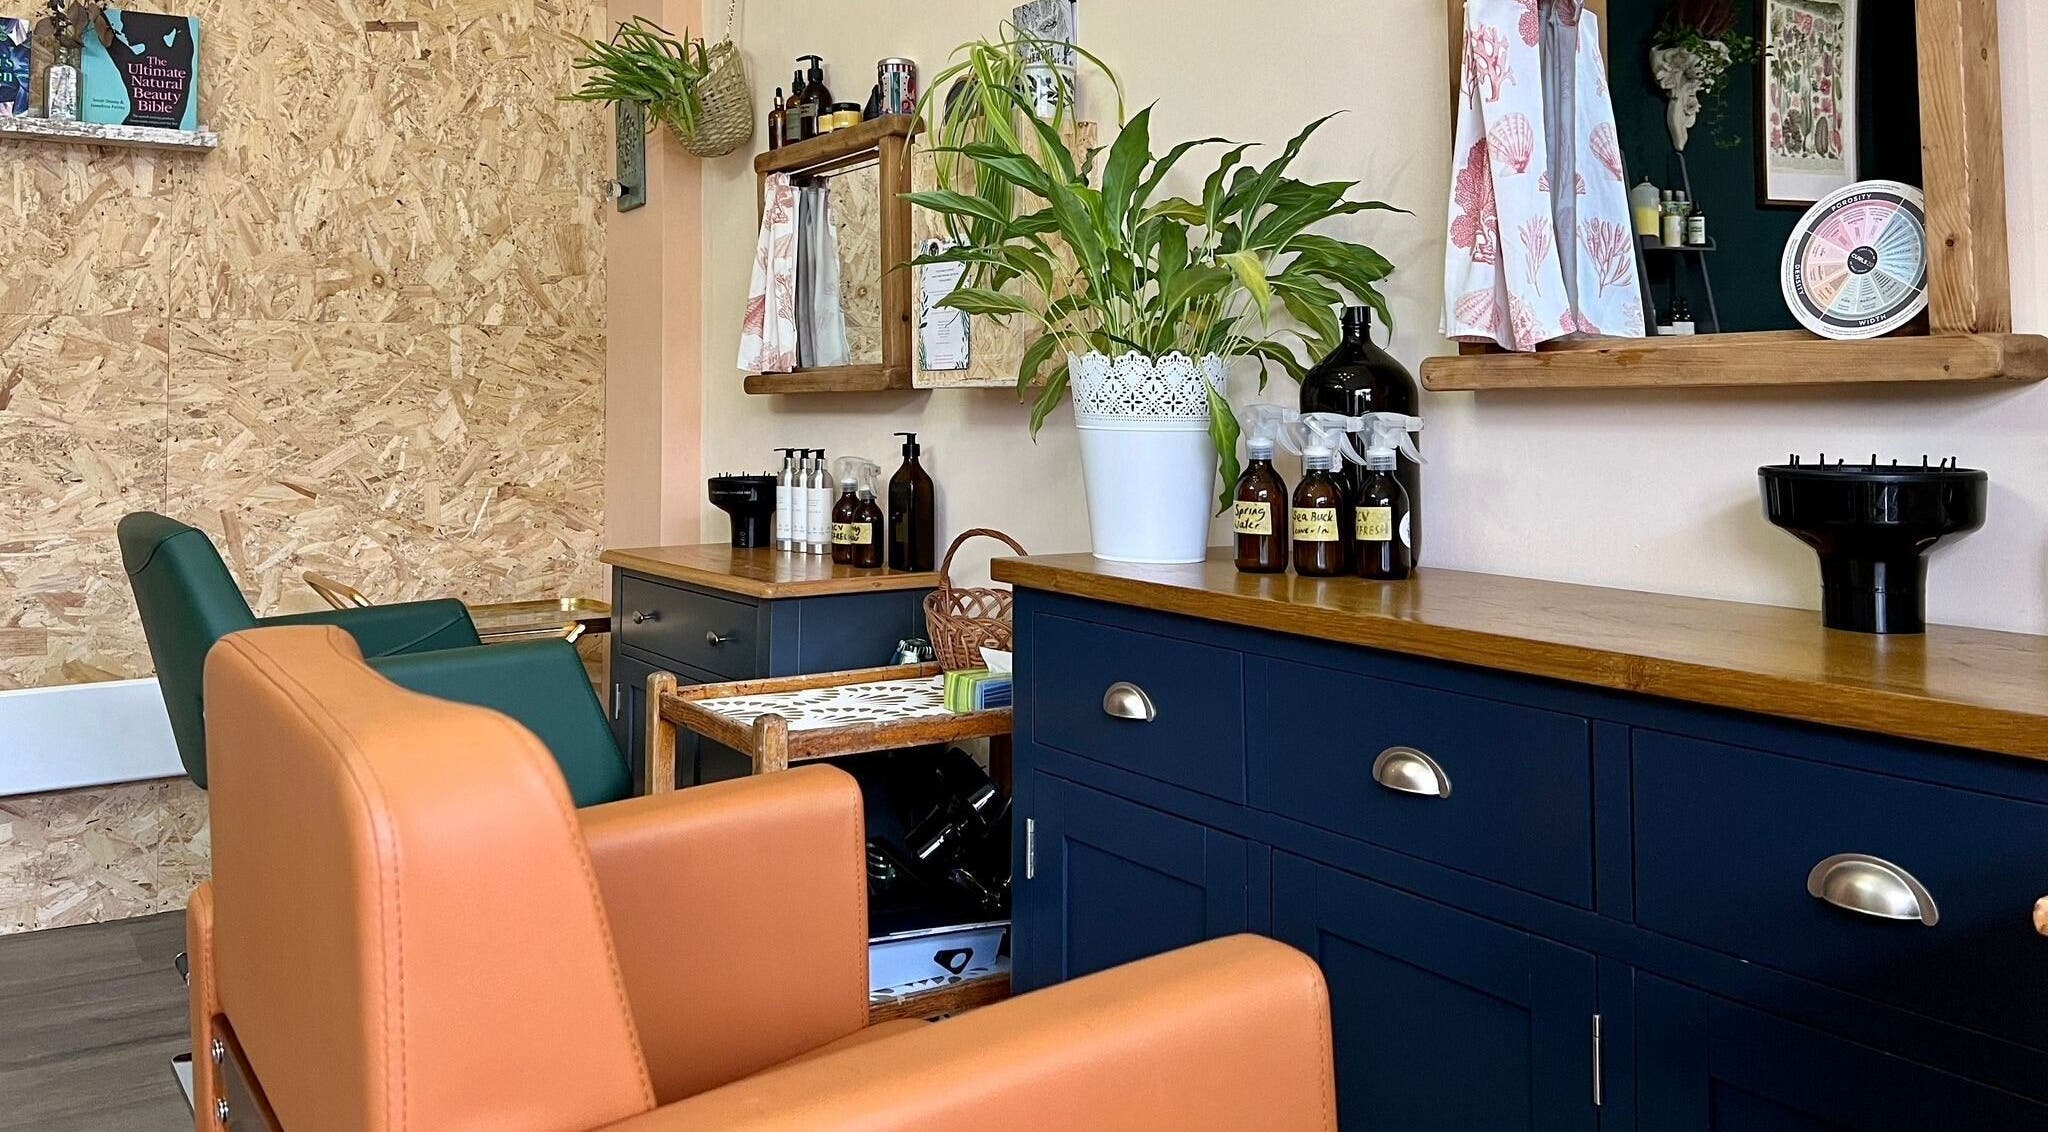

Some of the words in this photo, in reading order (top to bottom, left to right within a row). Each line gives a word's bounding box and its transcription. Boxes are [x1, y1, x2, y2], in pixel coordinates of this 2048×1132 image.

[146, 56, 168, 66] The
[128, 63, 187, 79] Ultimate
[131, 75, 183, 90] Natural
[133, 87, 181, 105] Beauty
[138, 100, 173, 113] Bible
[1831, 193, 1872, 212] POROSITY
[1794, 264, 1805, 295] DENSITY
[1858, 313, 1887, 326] WIDTH
[1235, 503, 1266, 521] Spring
